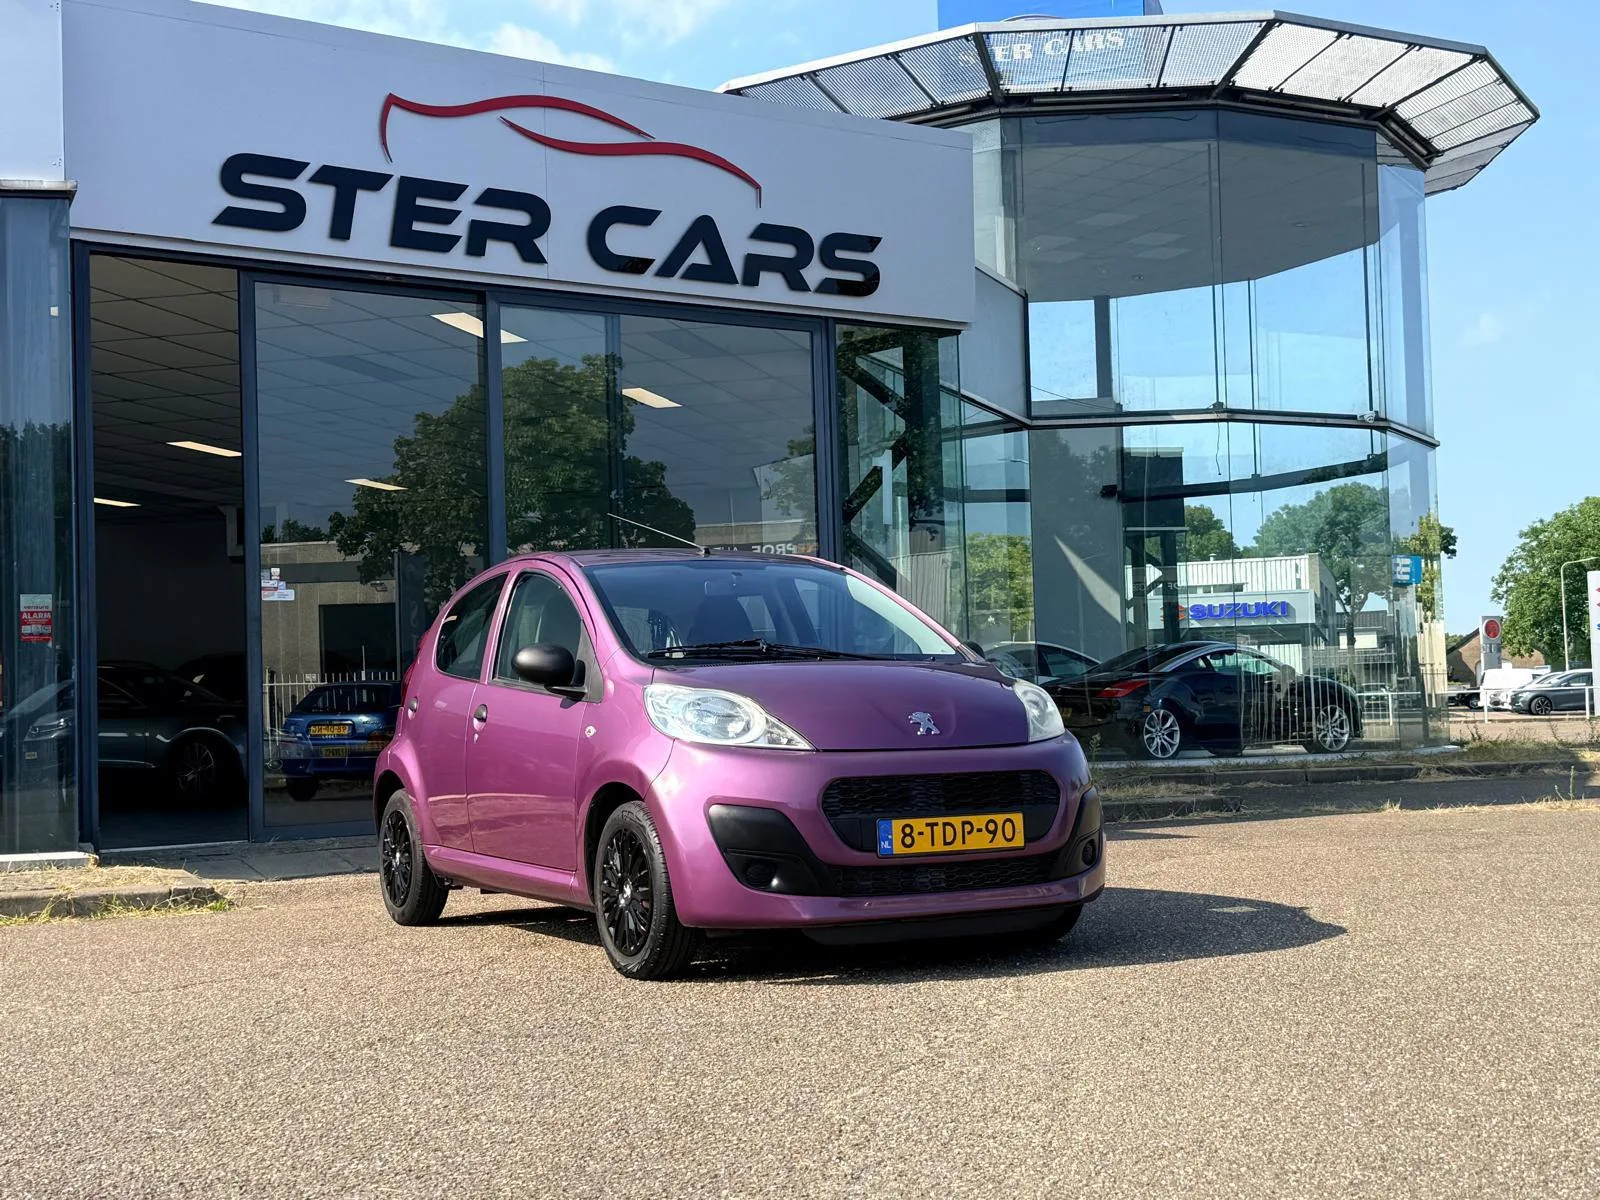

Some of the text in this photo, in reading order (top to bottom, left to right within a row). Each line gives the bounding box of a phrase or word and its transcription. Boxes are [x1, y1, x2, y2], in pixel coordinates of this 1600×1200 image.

[211, 152, 883, 297] STER CARS
[1189, 601, 1288, 620] SUZUKI
[901, 818, 1016, 849] 8-TDP-90
